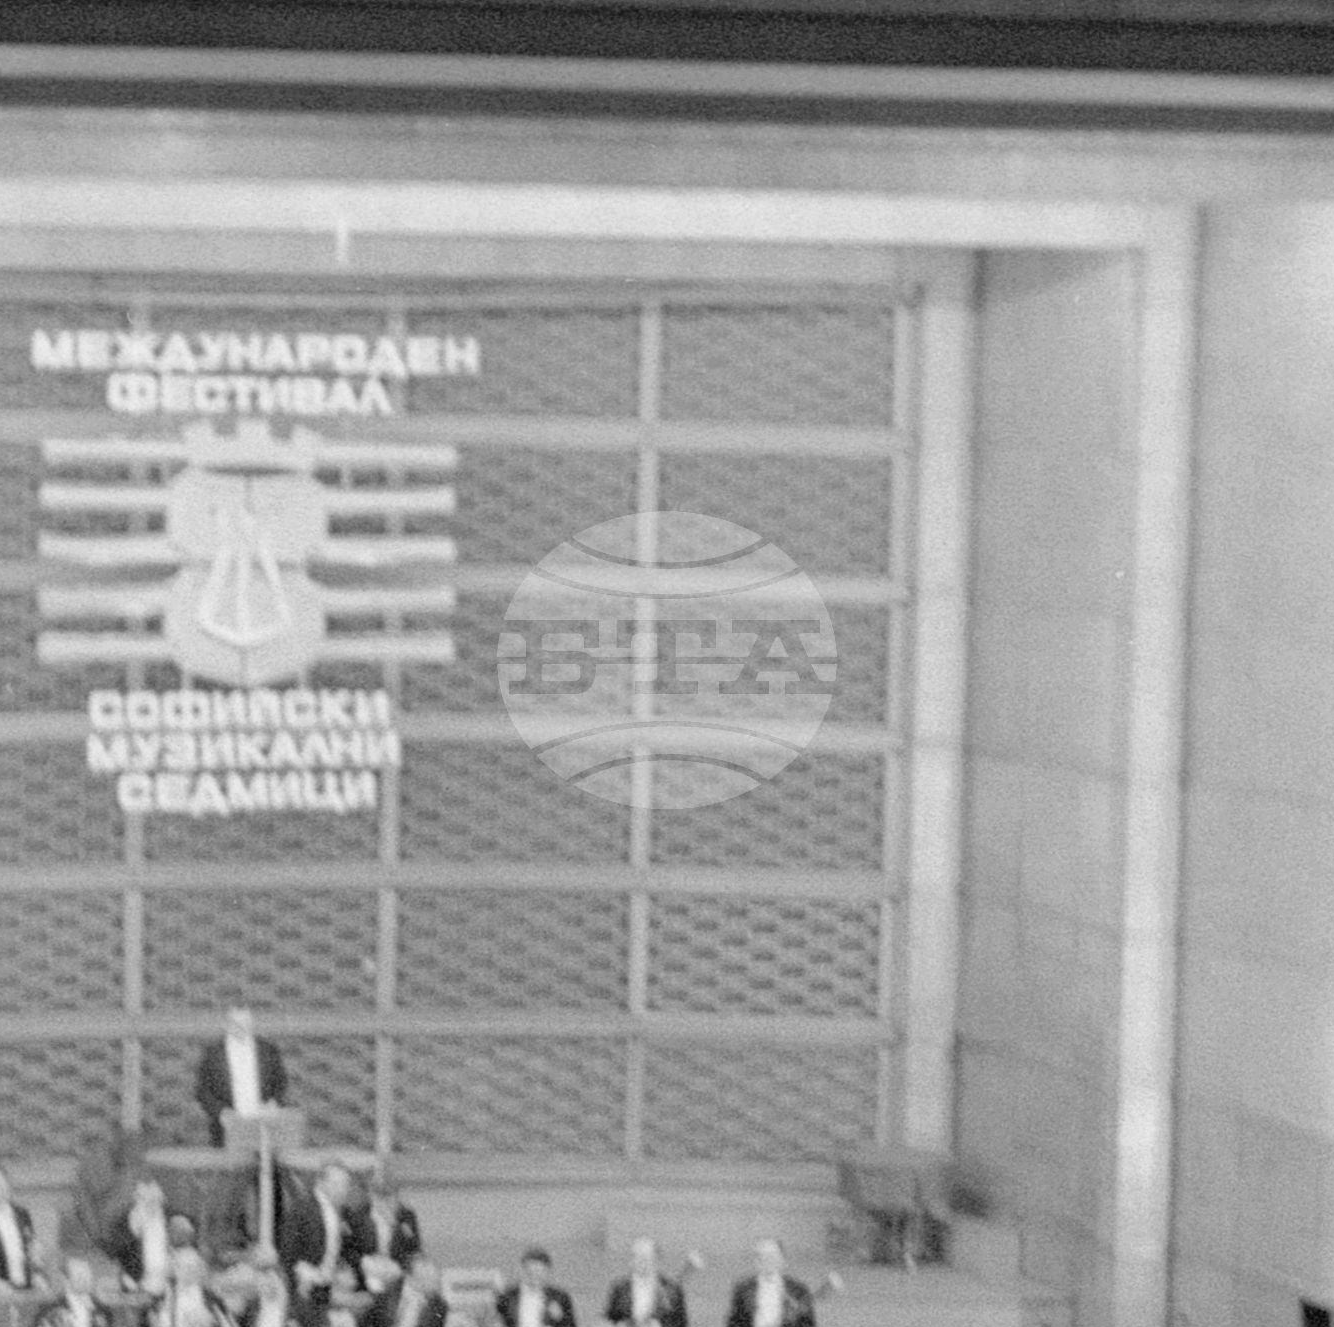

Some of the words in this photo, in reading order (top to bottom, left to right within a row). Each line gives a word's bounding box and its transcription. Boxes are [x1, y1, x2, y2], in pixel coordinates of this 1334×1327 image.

[30, 328, 481, 379] МЕЖДУНАРОДЕН
[105, 371, 394, 415] ФЕСТИВАЛ
[85, 729, 402, 774] МУЗИКАЛНИ
[117, 771, 378, 818] СЕДМИЦИ
